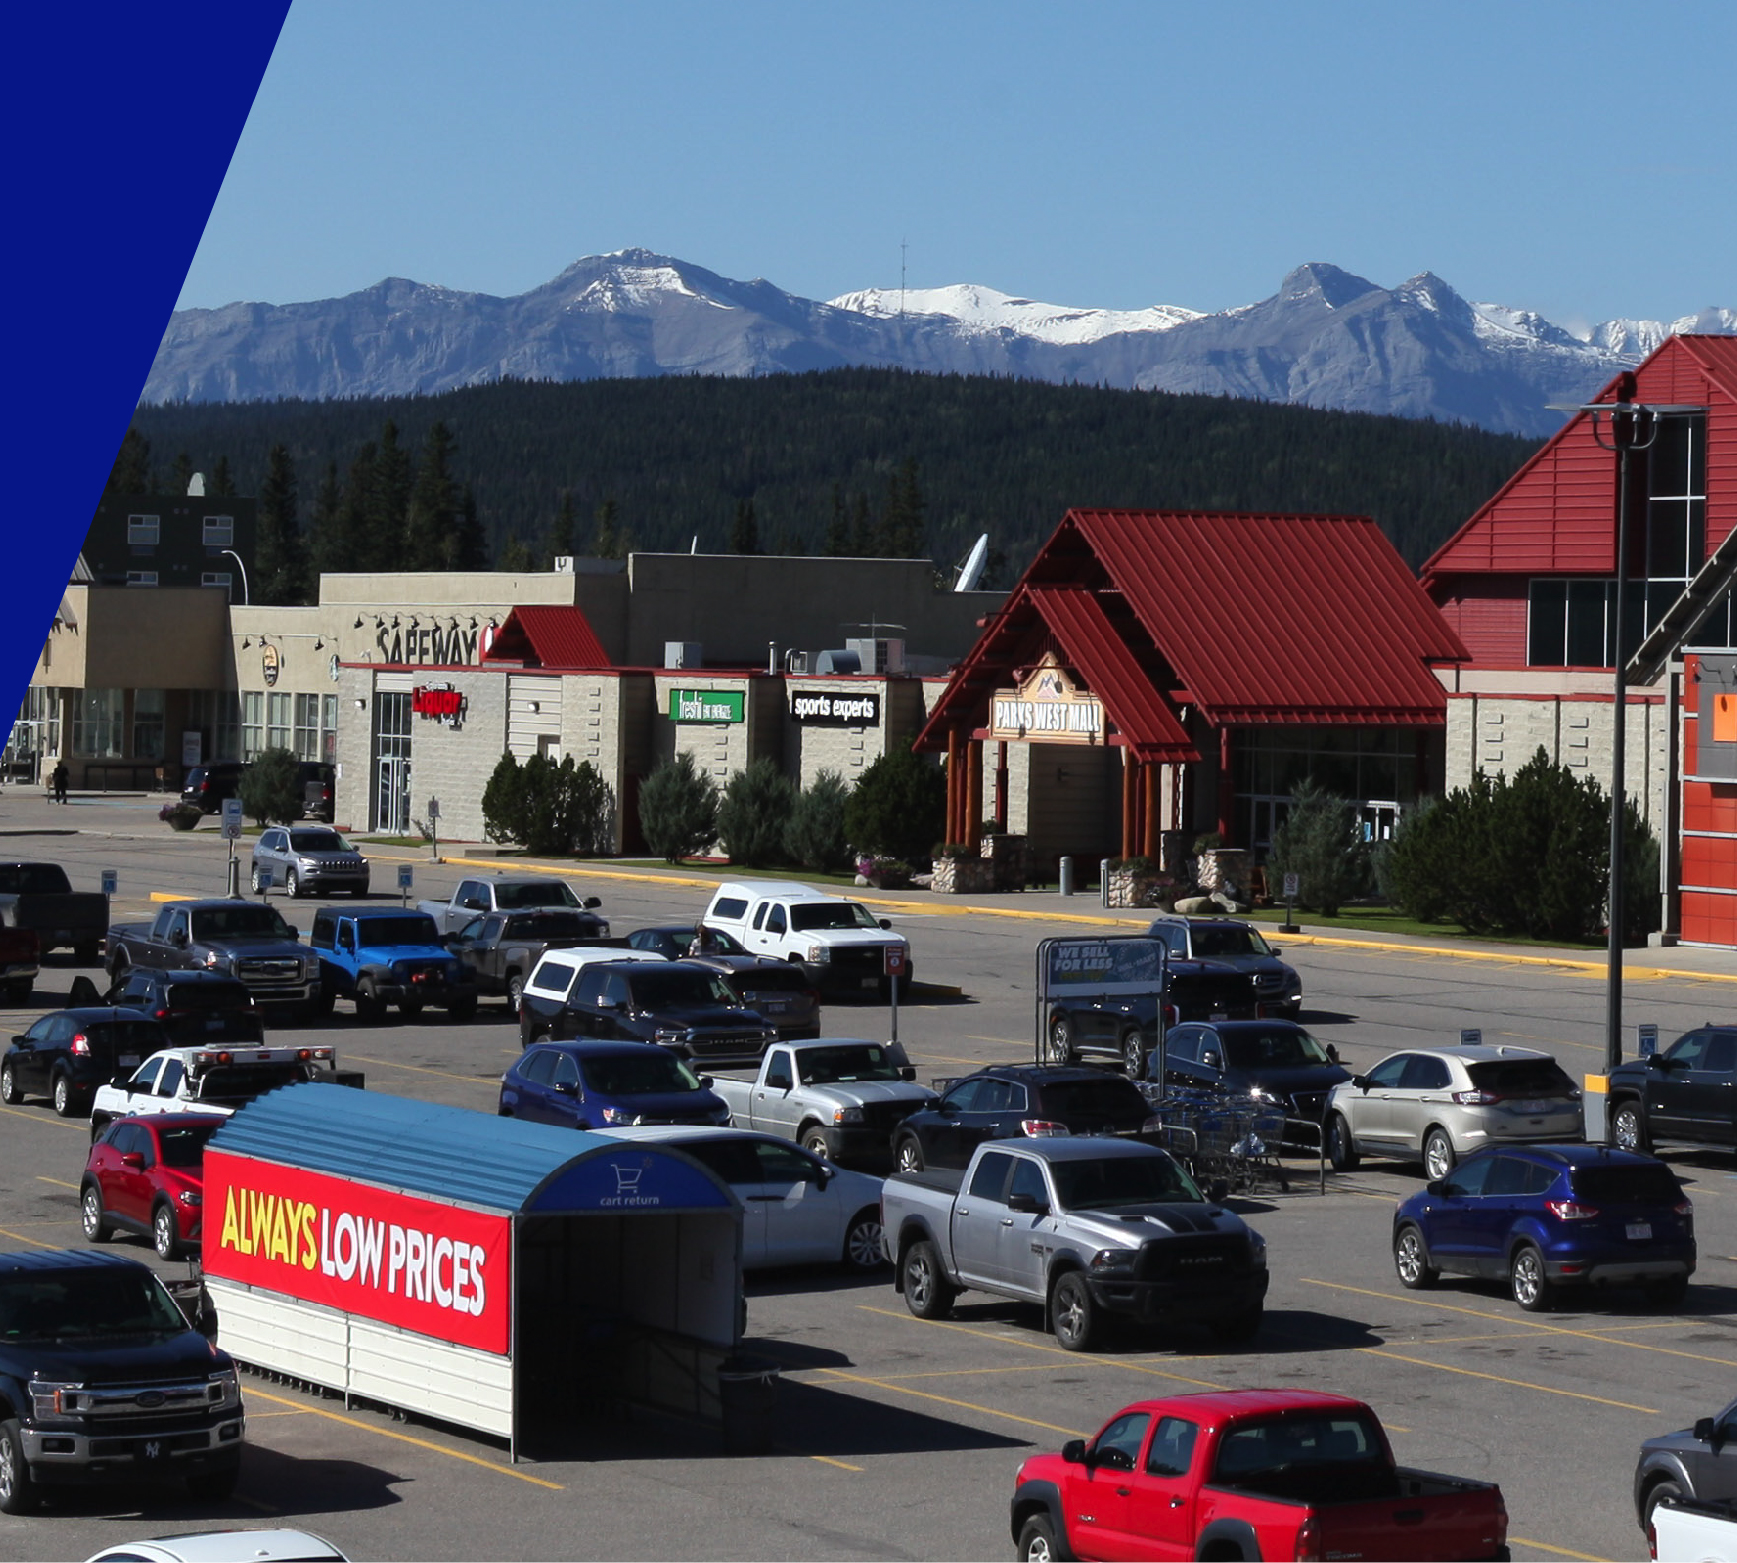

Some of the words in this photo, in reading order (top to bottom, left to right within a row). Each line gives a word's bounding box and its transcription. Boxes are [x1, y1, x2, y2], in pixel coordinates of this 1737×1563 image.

[795, 696, 831, 720] sports
[833, 698, 874, 721] experts
[996, 700, 1033, 730] PARKS
[1034, 702, 1068, 731] WEST
[1069, 703, 1100, 732] MALL
[1058, 947, 1080, 958] WE
[1081, 946, 1109, 958] SELL
[1054, 959, 1081, 971] FOR
[1083, 957, 1113, 970] LESS
[600, 1196, 621, 1206] cart
[624, 1196, 659, 1205] return
[220, 1185, 317, 1270] ALWAYS
[321, 1208, 385, 1290] LOW
[387, 1224, 486, 1317] PRICES
